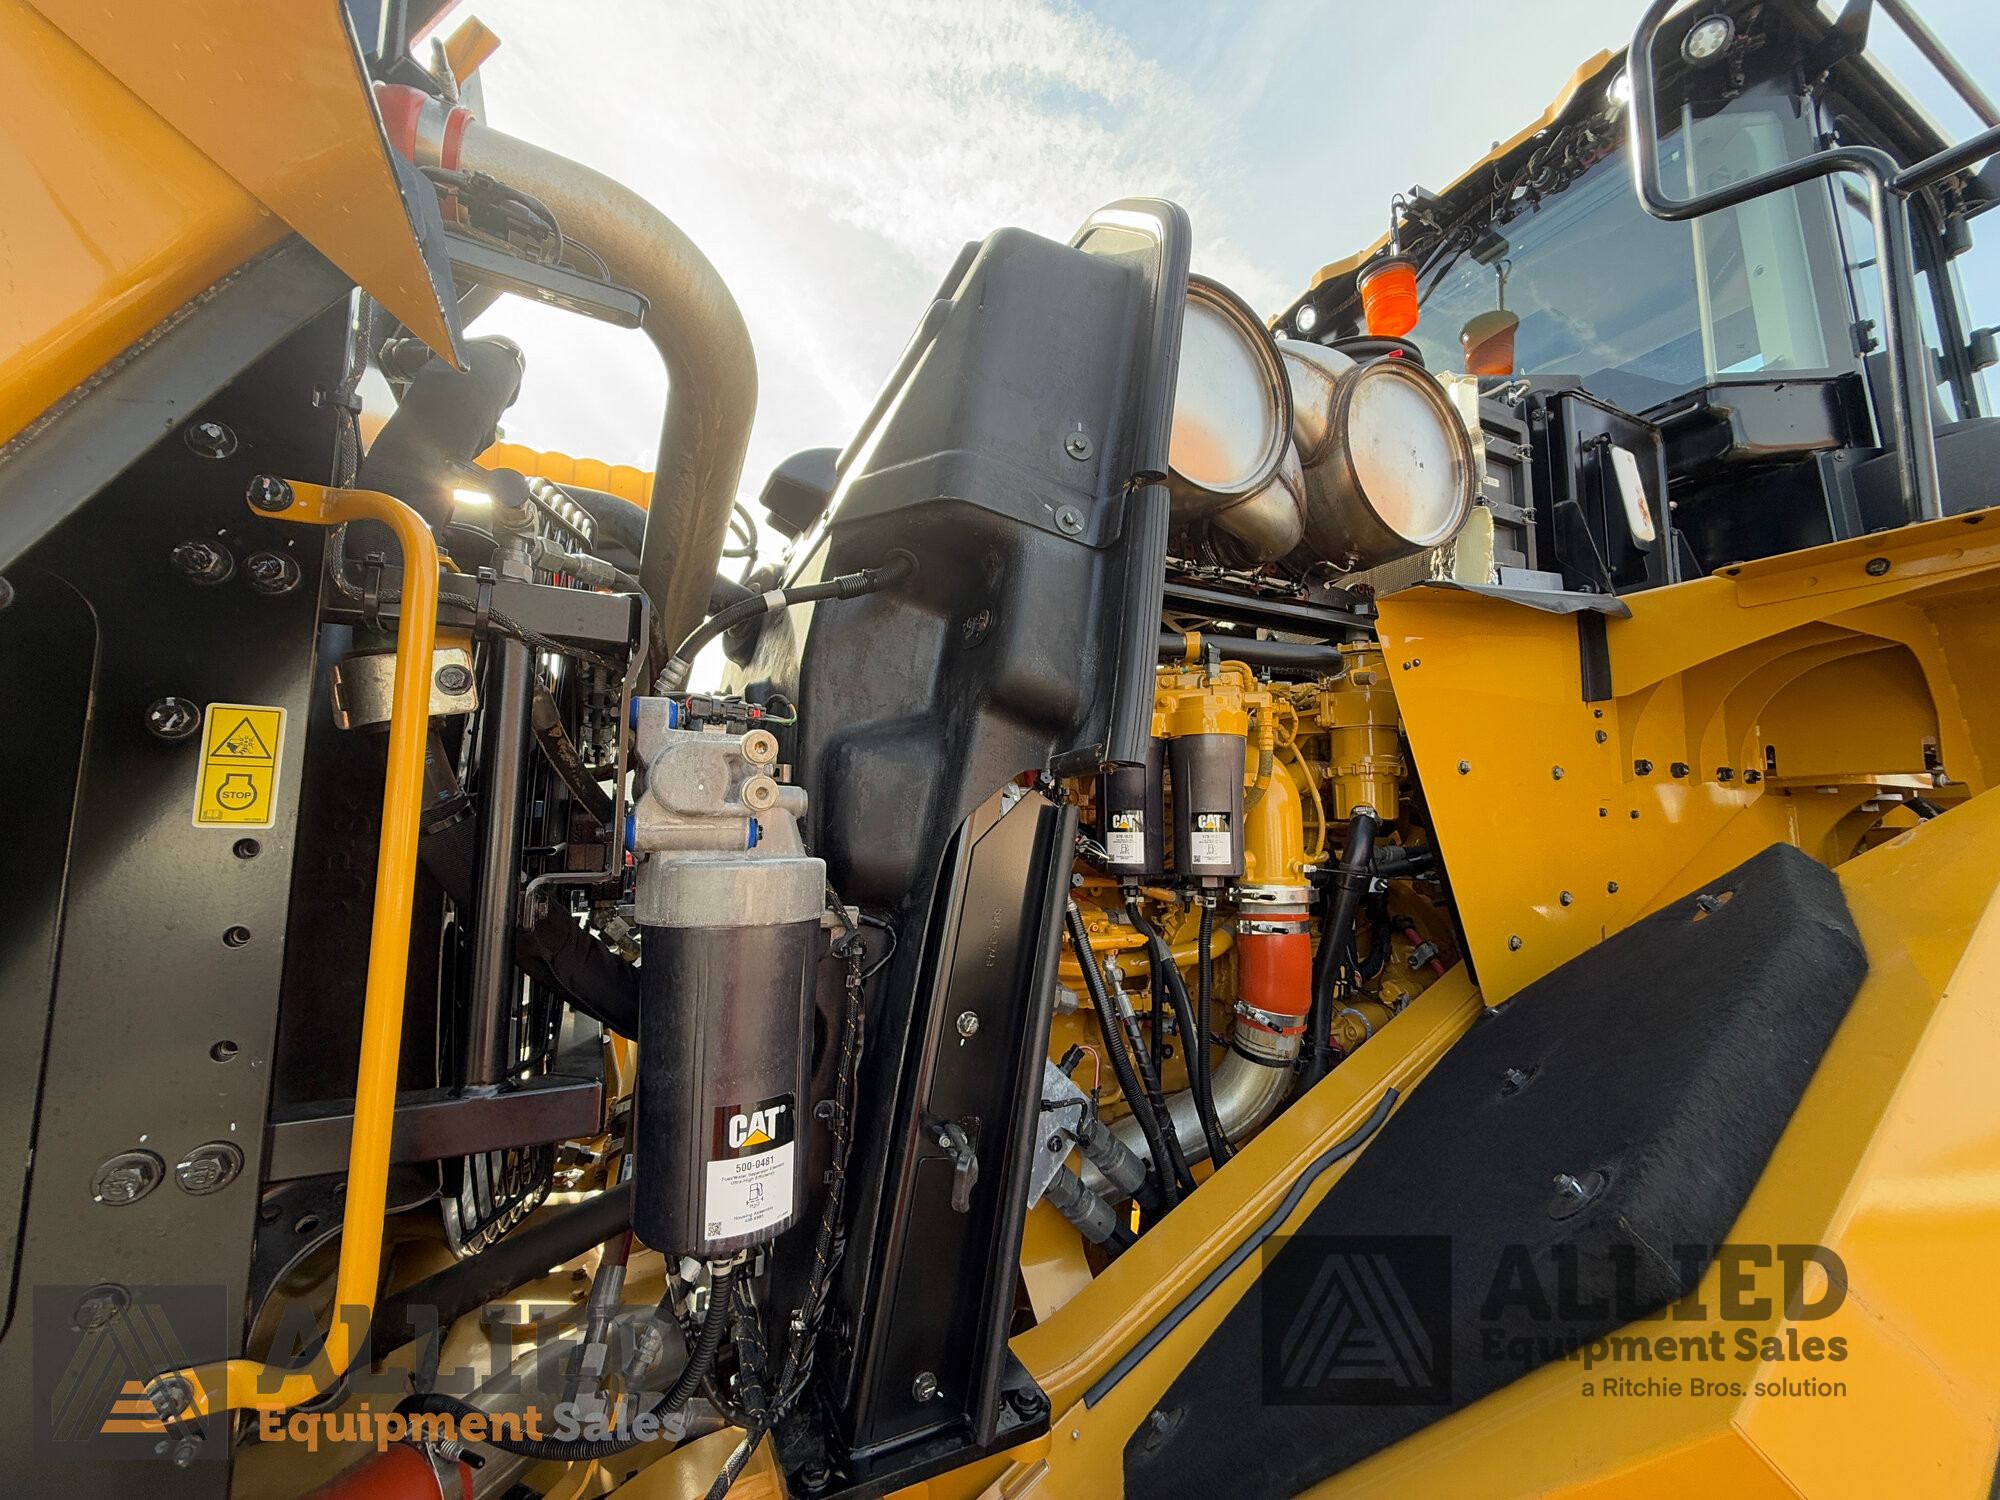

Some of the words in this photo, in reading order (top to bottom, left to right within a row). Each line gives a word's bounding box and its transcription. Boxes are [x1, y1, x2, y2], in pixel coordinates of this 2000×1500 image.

[222, 791, 252, 799] STOP
[1112, 814, 1135, 828] CAT
[1197, 814, 1221, 828] CAT
[728, 1105, 780, 1149] CAT
[735, 1155, 774, 1173] 500-0481
